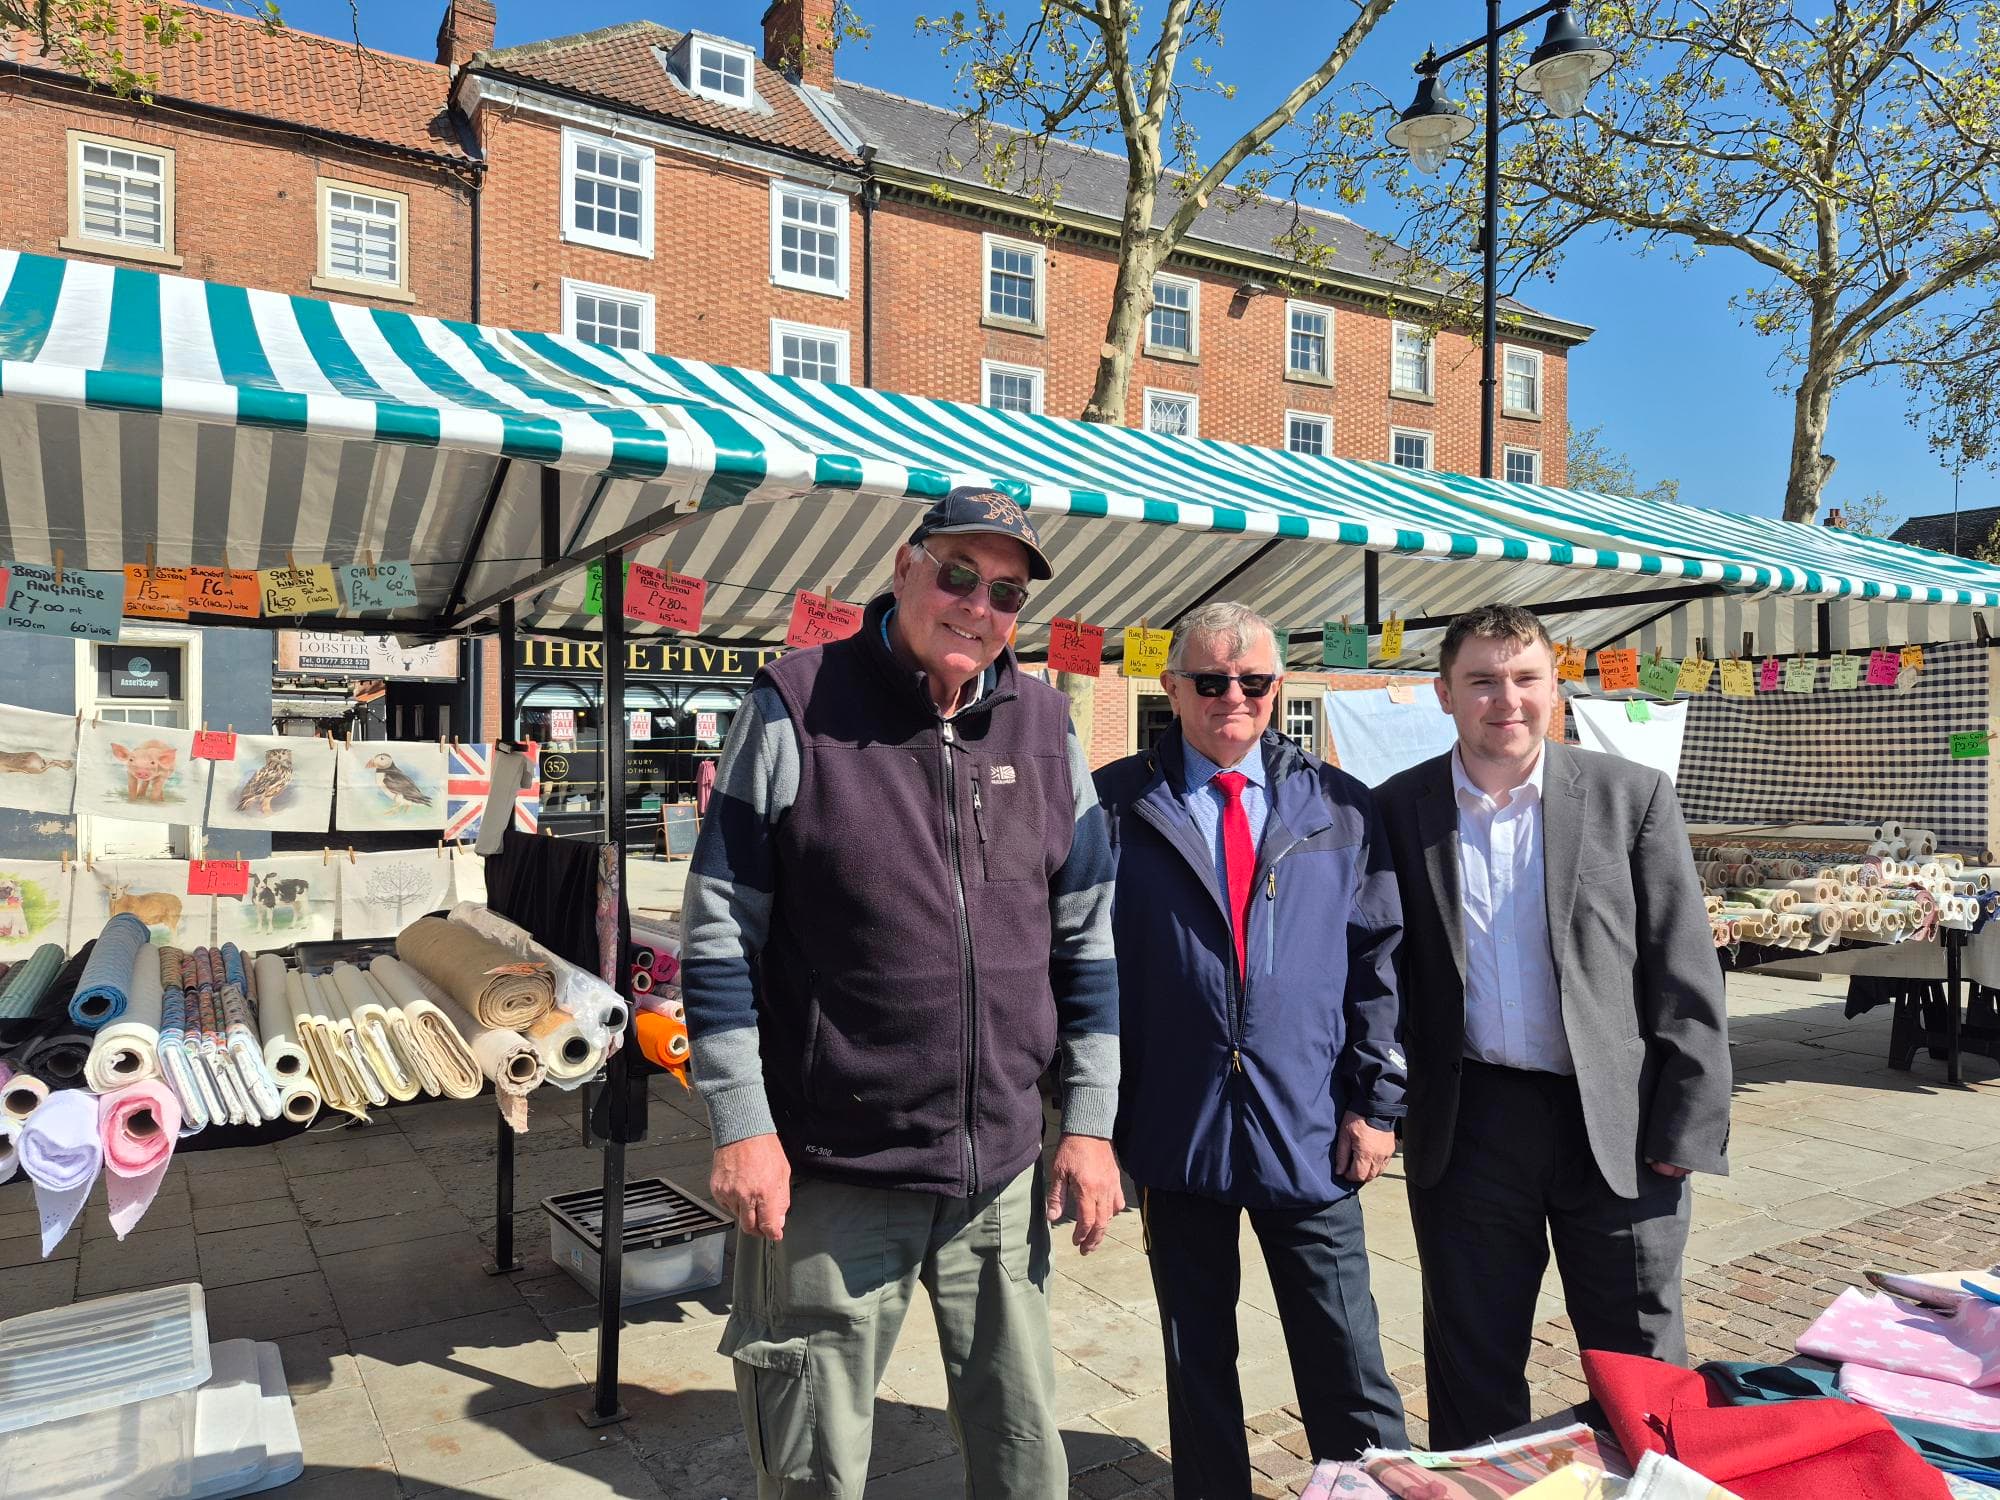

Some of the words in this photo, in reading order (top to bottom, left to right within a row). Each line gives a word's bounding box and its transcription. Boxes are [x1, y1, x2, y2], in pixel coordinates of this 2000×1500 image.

[12, 565, 86, 586] BRODRIE
[202, 579, 222, 596] £6
[299, 642, 369, 655] LOBSTER
[522, 640, 650, 669] THRE
[661, 645, 743, 673] FIVE
[120, 678, 159, 688] AssetScape
[552, 720, 574, 728] SALE
[546, 761, 565, 774] 352
[805, 1143, 833, 1157] KS-300
